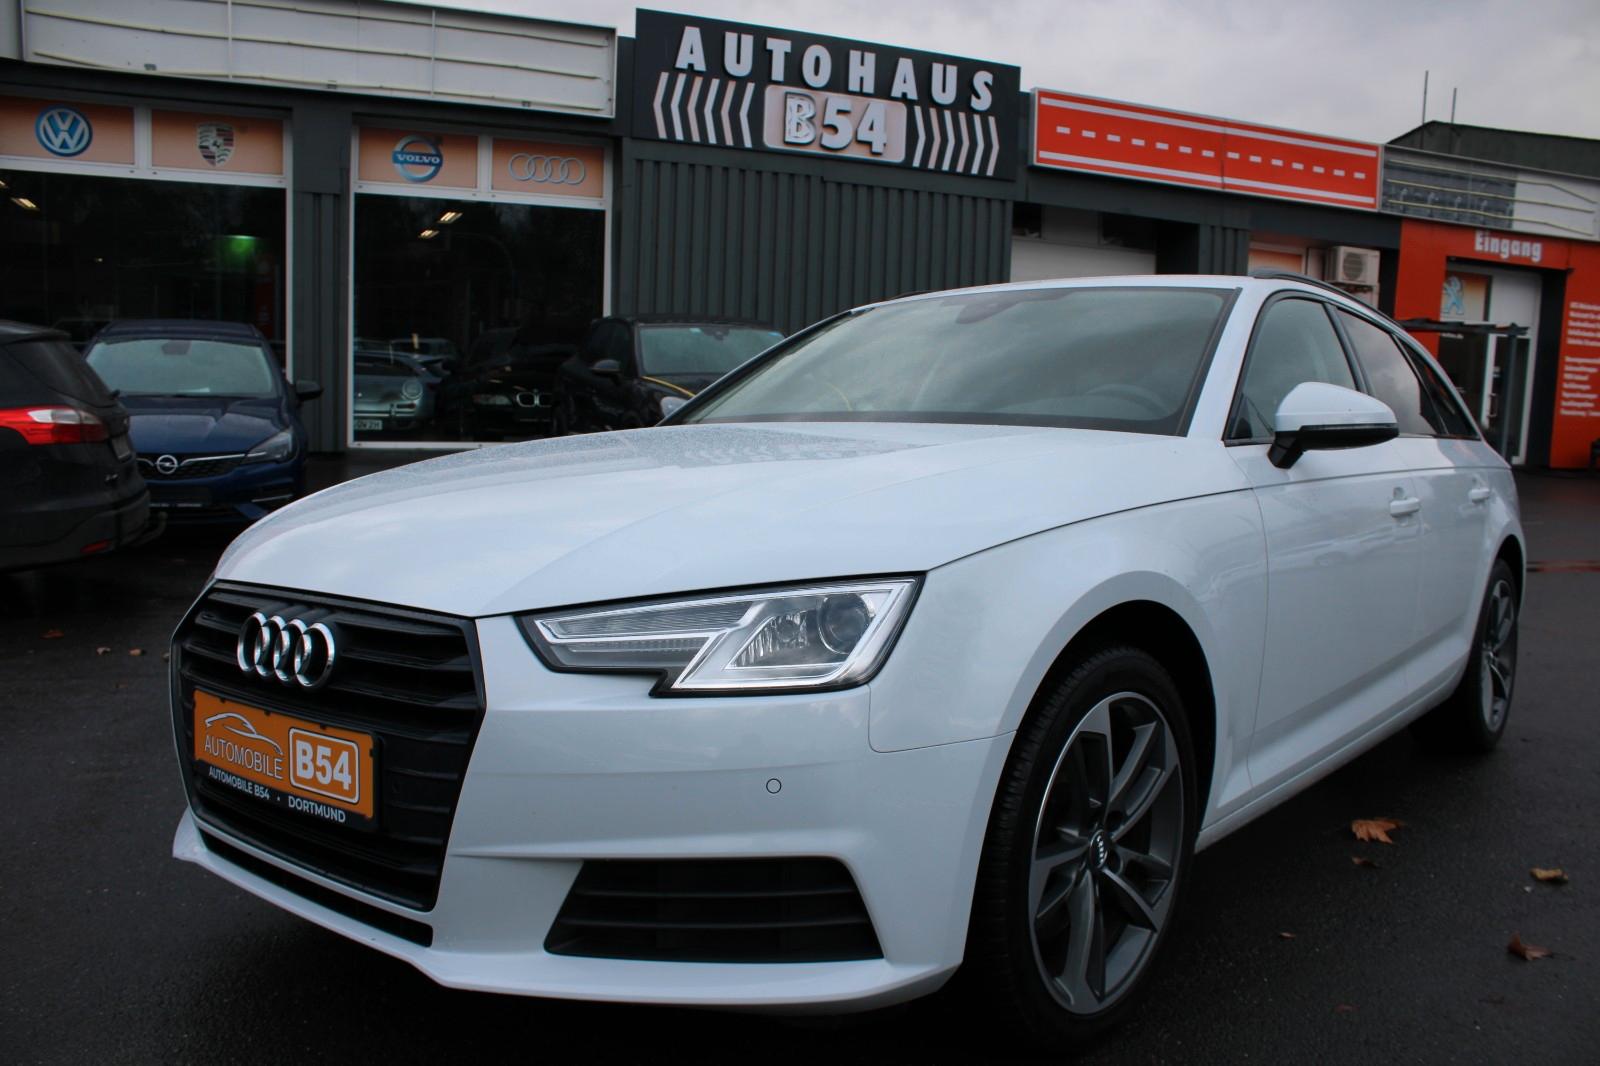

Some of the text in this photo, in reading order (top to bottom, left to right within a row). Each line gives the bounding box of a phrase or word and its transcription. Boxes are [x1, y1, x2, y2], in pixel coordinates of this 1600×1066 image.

[674, 26, 993, 112] AUTOHAUS
[784, 91, 887, 155] B54
[397, 154, 440, 164] VOLVO
[1476, 231, 1541, 262] Eingang
[204, 735, 284, 780] AUTOMOBILE
[296, 740, 351, 791] B54
[208, 766, 346, 823] AUTOMOBILE B54 DORTMUND
